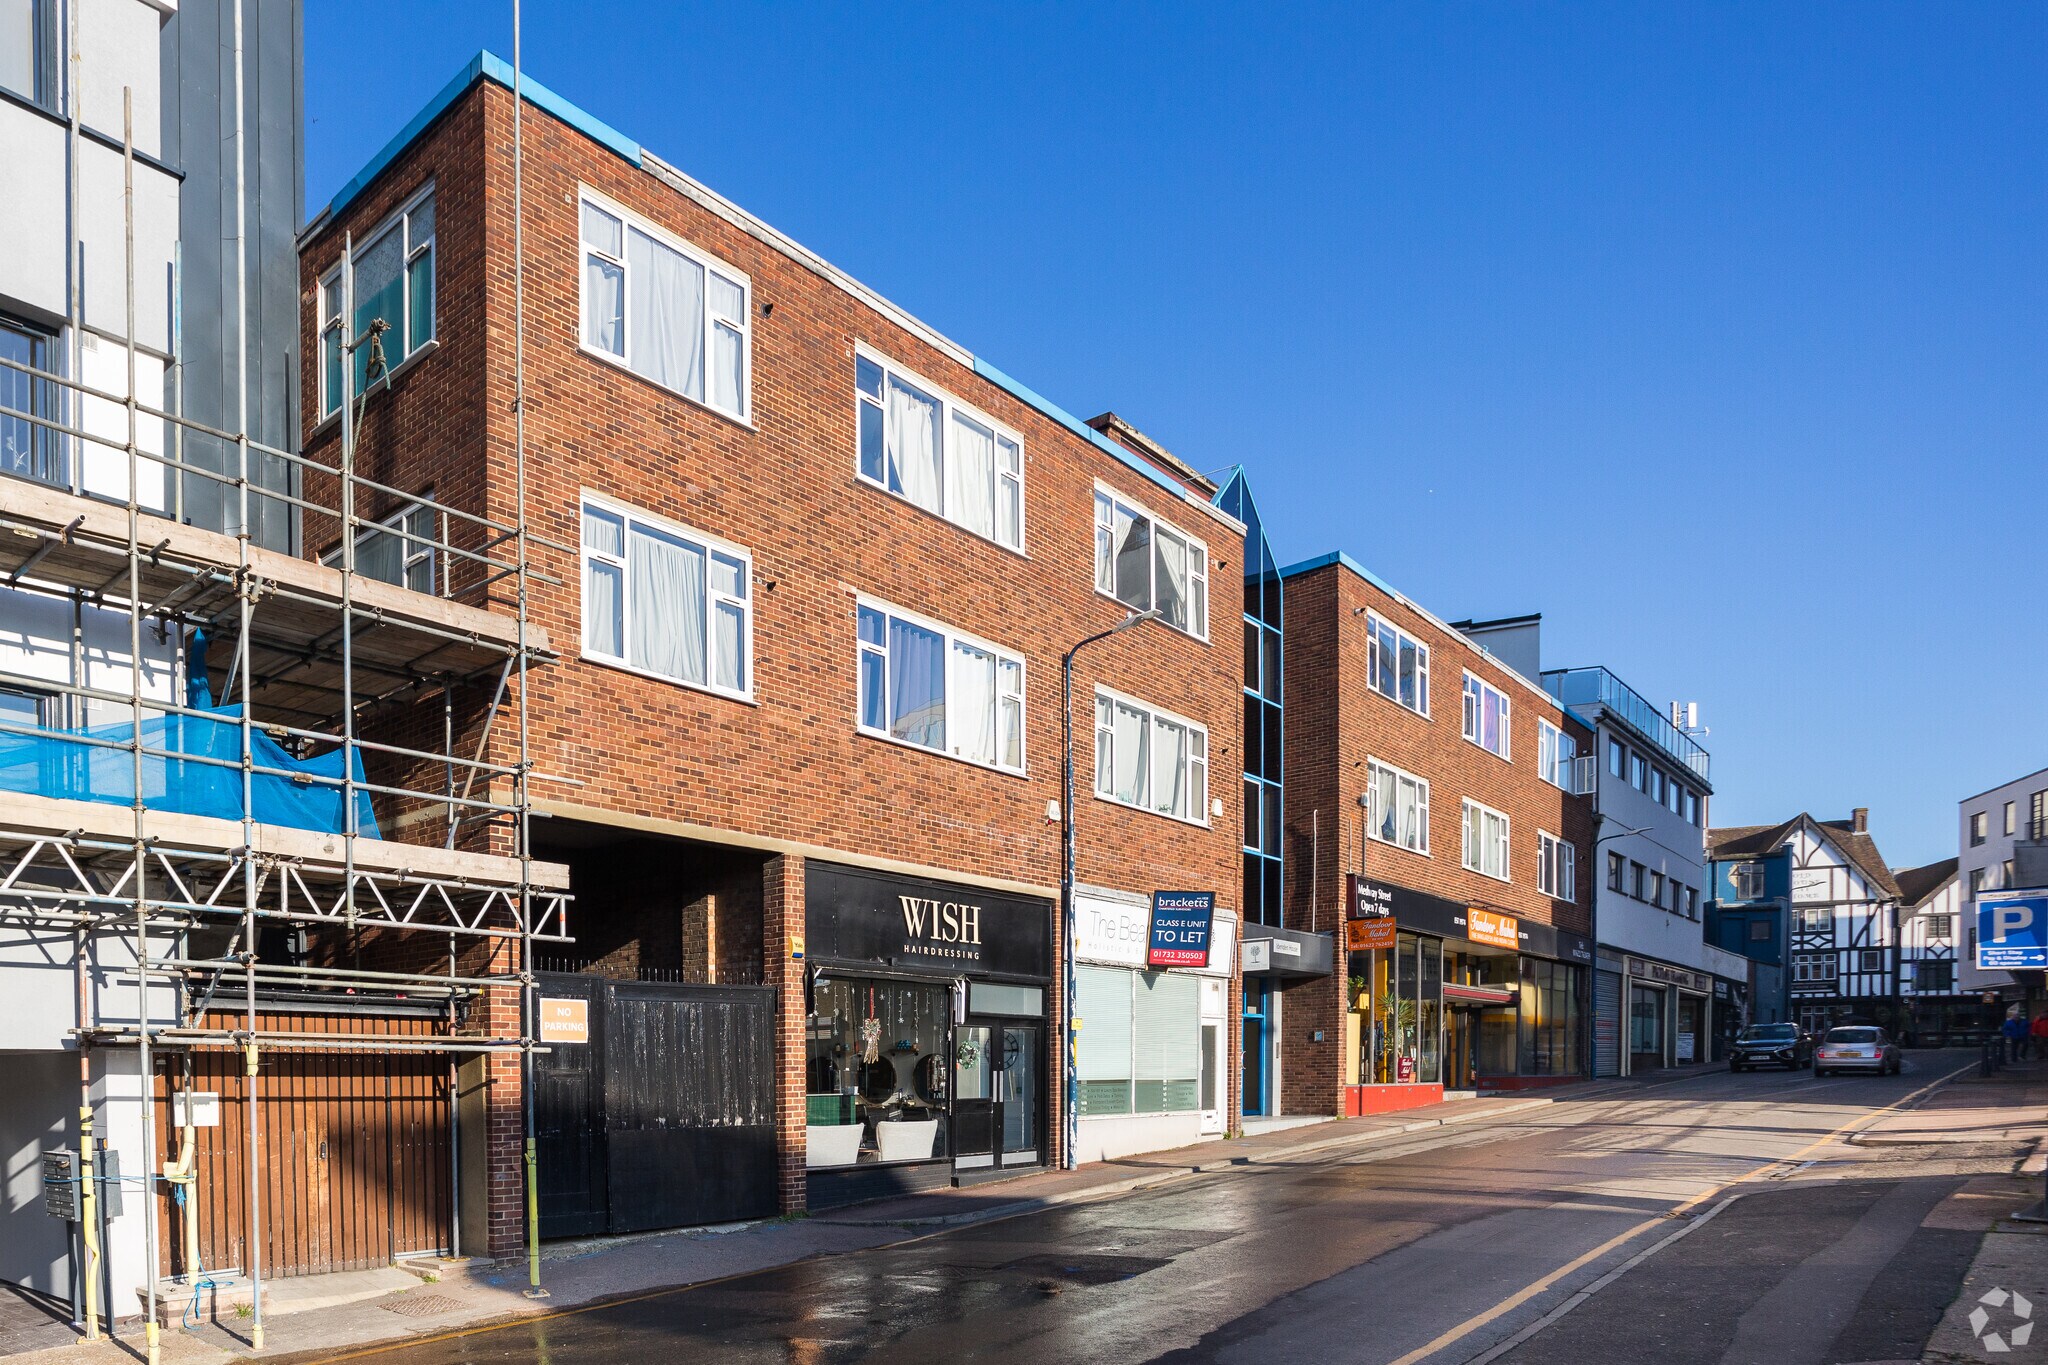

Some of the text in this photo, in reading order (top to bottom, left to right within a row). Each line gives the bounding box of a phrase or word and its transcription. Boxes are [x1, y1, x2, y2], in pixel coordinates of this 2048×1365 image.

[1358, 884, 1392, 902] Medway Street
[1158, 897, 1209, 908] bracketts
[1360, 900, 1390, 918] Open 7 days
[898, 895, 982, 945] WISH
[1090, 910, 1116, 939] The
[1156, 919, 1179, 927] CLASS
[1362, 920, 1392, 930] Tandoor
[1470, 911, 1516, 939] Tandoor Mahal
[1992, 906, 2034, 943] P
[1155, 930, 1205, 943] TO LET
[1365, 929, 1390, 939] Mahal
[903, 944, 980, 960] HAIRDRESSING
[557, 1007, 572, 1017] NO
[544, 1021, 585, 1032] PARKING
